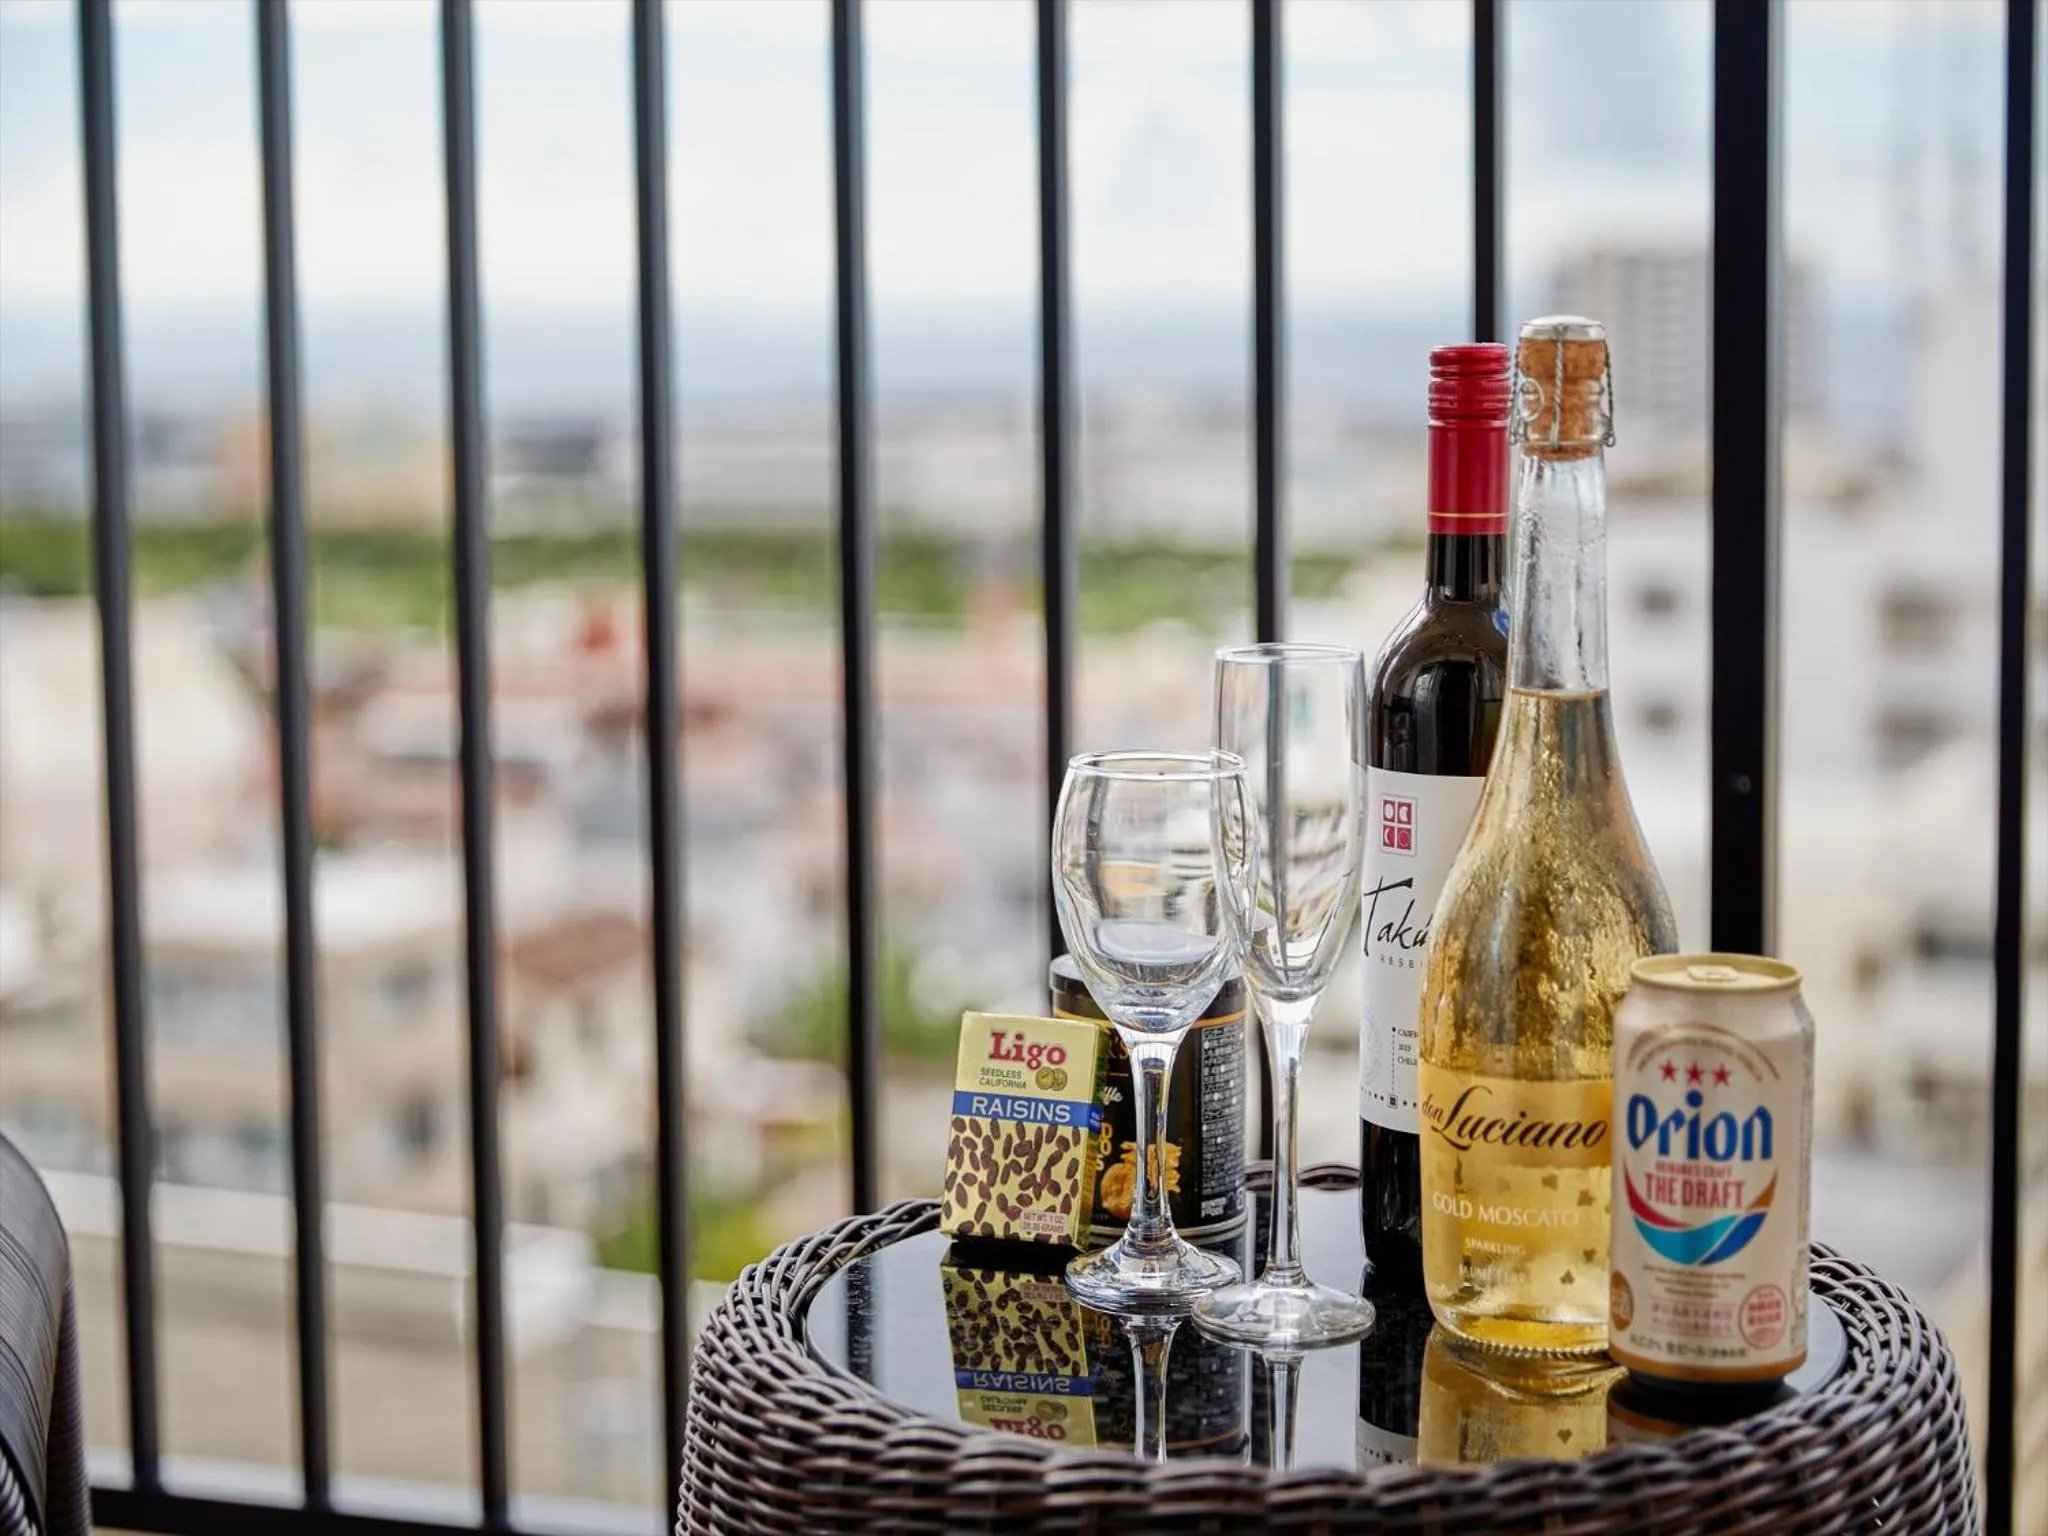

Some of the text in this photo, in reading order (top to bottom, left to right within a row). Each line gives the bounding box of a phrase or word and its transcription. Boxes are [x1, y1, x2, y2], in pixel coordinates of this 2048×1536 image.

[1380, 954, 1423, 969] RESE
[988, 1031, 1067, 1070] Ligo
[979, 1077, 1027, 1090] CALIFORNIA
[980, 1067, 1022, 1079] SEEDLESS
[972, 1096, 1072, 1123] RAISINS
[1422, 1085, 1608, 1151] don Luciano
[1626, 1089, 1774, 1162] Orion
[1644, 1171, 1746, 1209] THE DRAFT
[1432, 1191, 1580, 1228] GOLD MOSCATO
[1465, 1237, 1526, 1255] SPARKLING
